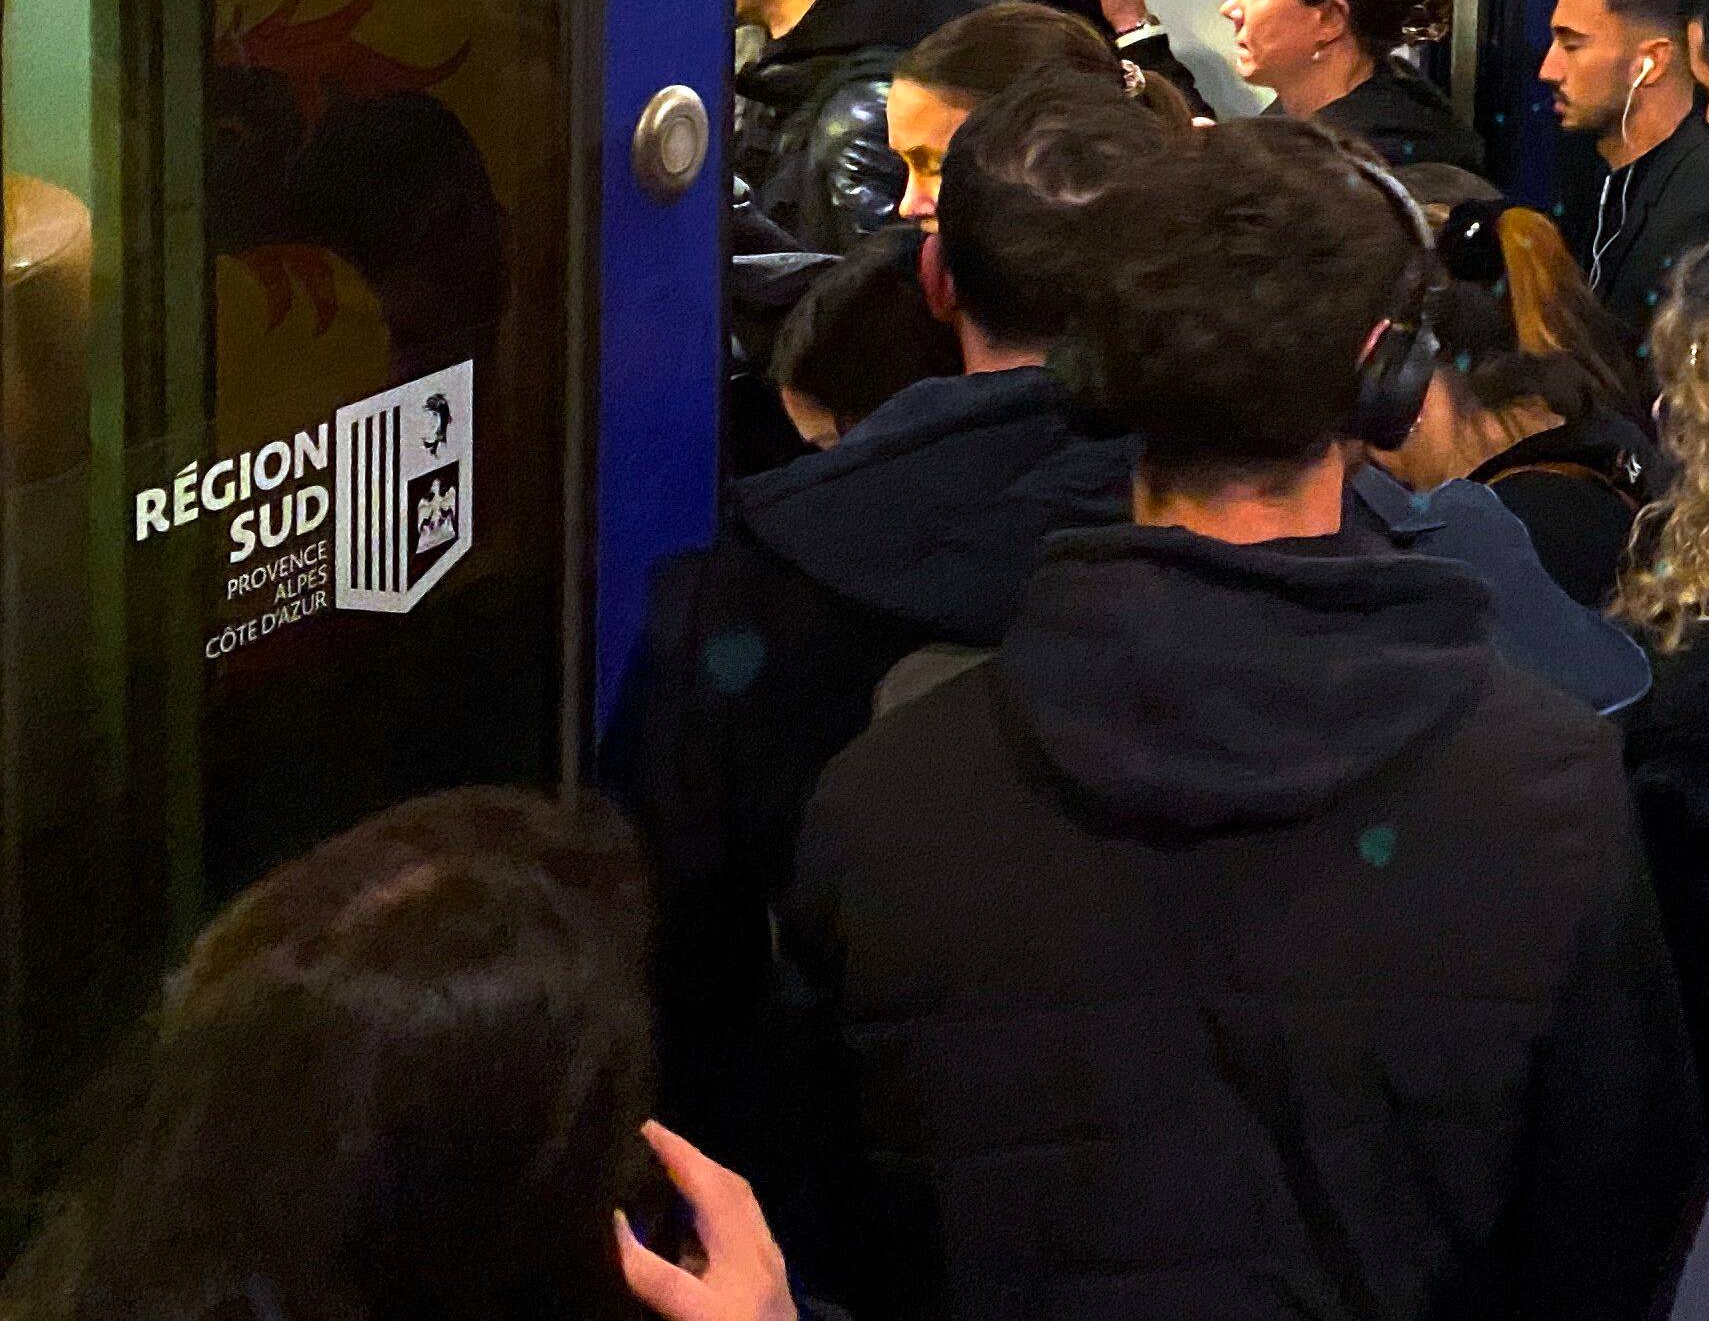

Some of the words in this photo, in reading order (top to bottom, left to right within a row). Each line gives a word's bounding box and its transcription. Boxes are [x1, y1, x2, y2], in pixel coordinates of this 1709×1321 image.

[136, 423, 329, 542] RÉGION
[230, 485, 329, 563] SUD
[227, 540, 328, 600] PROVENCE
[274, 566, 328, 604] ALPES
[205, 622, 259, 659] CÔTE
[261, 590, 328, 634] D'AZUR
